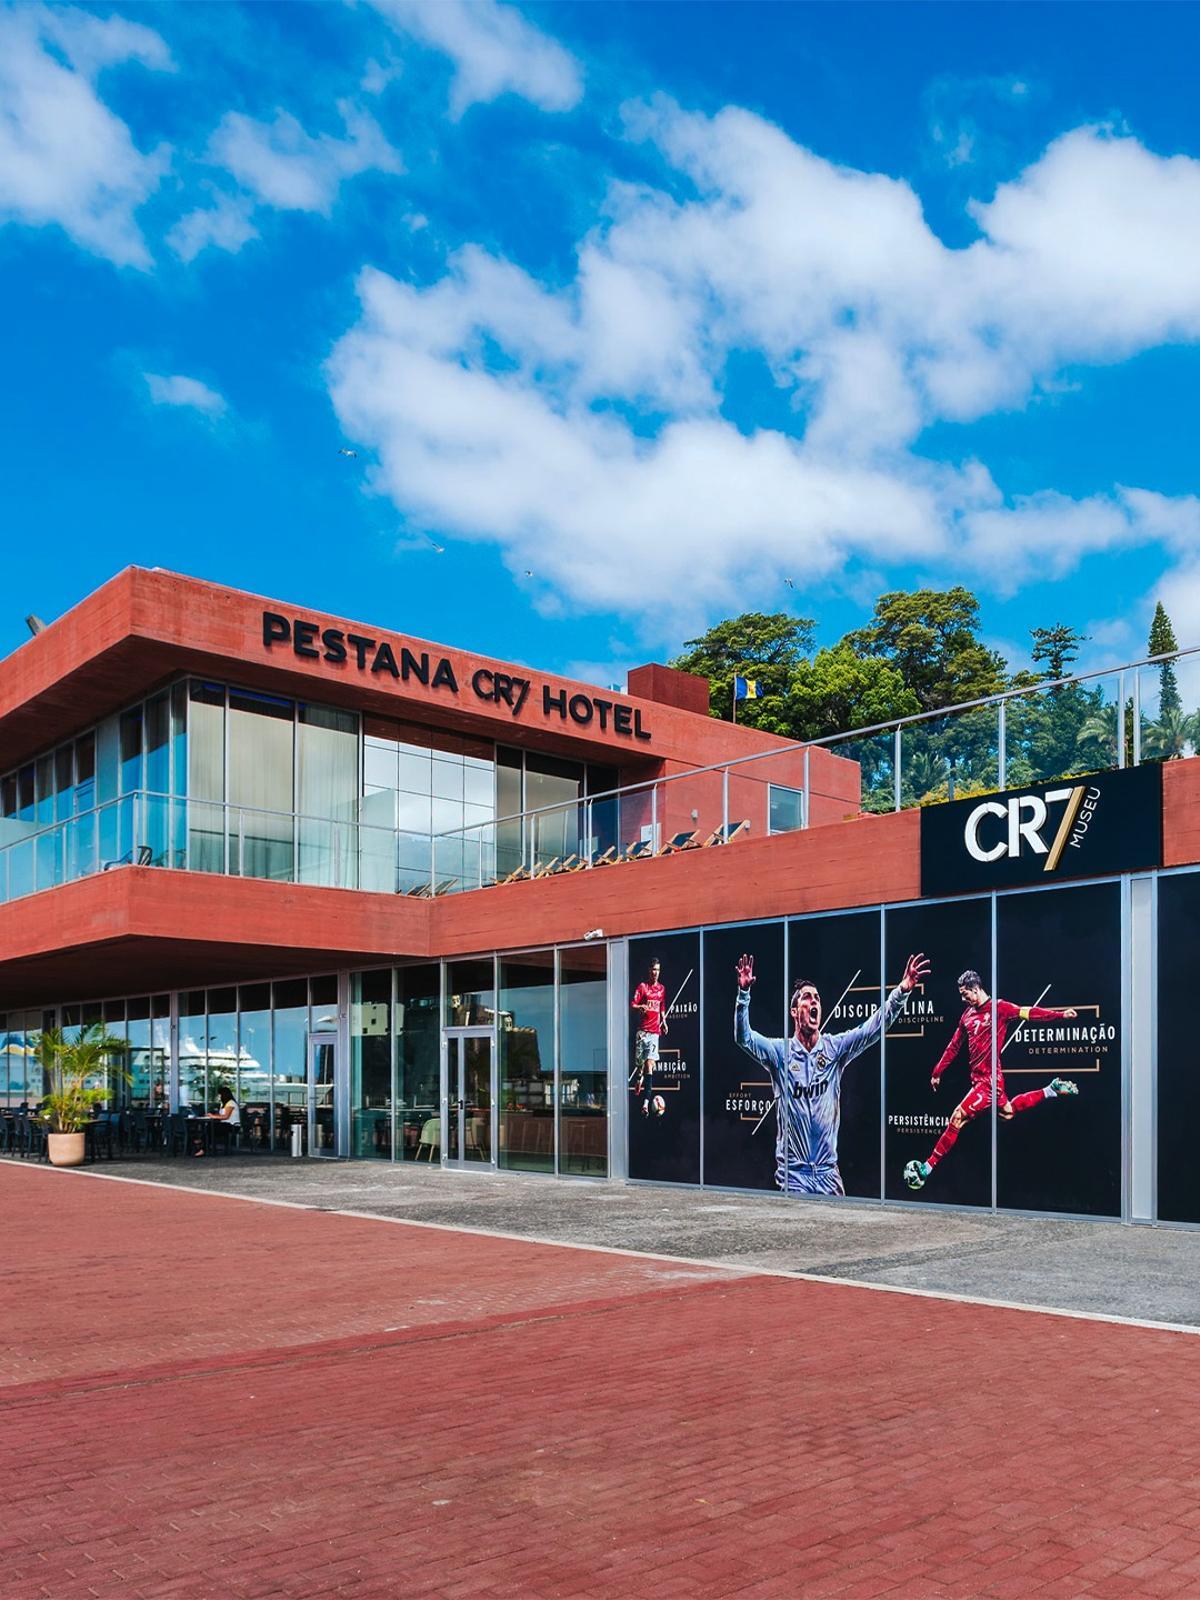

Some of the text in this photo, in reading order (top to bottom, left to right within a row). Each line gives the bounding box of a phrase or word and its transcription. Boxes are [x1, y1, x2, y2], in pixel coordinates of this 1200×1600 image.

[262, 611, 652, 740] PESTANA CR7 HOTEL
[1069, 787, 1101, 848] MUSEU
[964, 786, 1086, 871] CR7
[670, 1002, 697, 1014] PAIXÃO
[898, 1016, 944, 1024] DISCIPLINE
[1015, 1023, 1115, 1043] DETERMINAÇÃO
[1029, 1046, 1108, 1055] DETERMINATION
[653, 1060, 687, 1073] AMBIÇÃO
[792, 1078, 829, 1099] bwin
[726, 1099, 771, 1114] ESFORÇO
[888, 1114, 949, 1126] PERSISTÊNCIA
